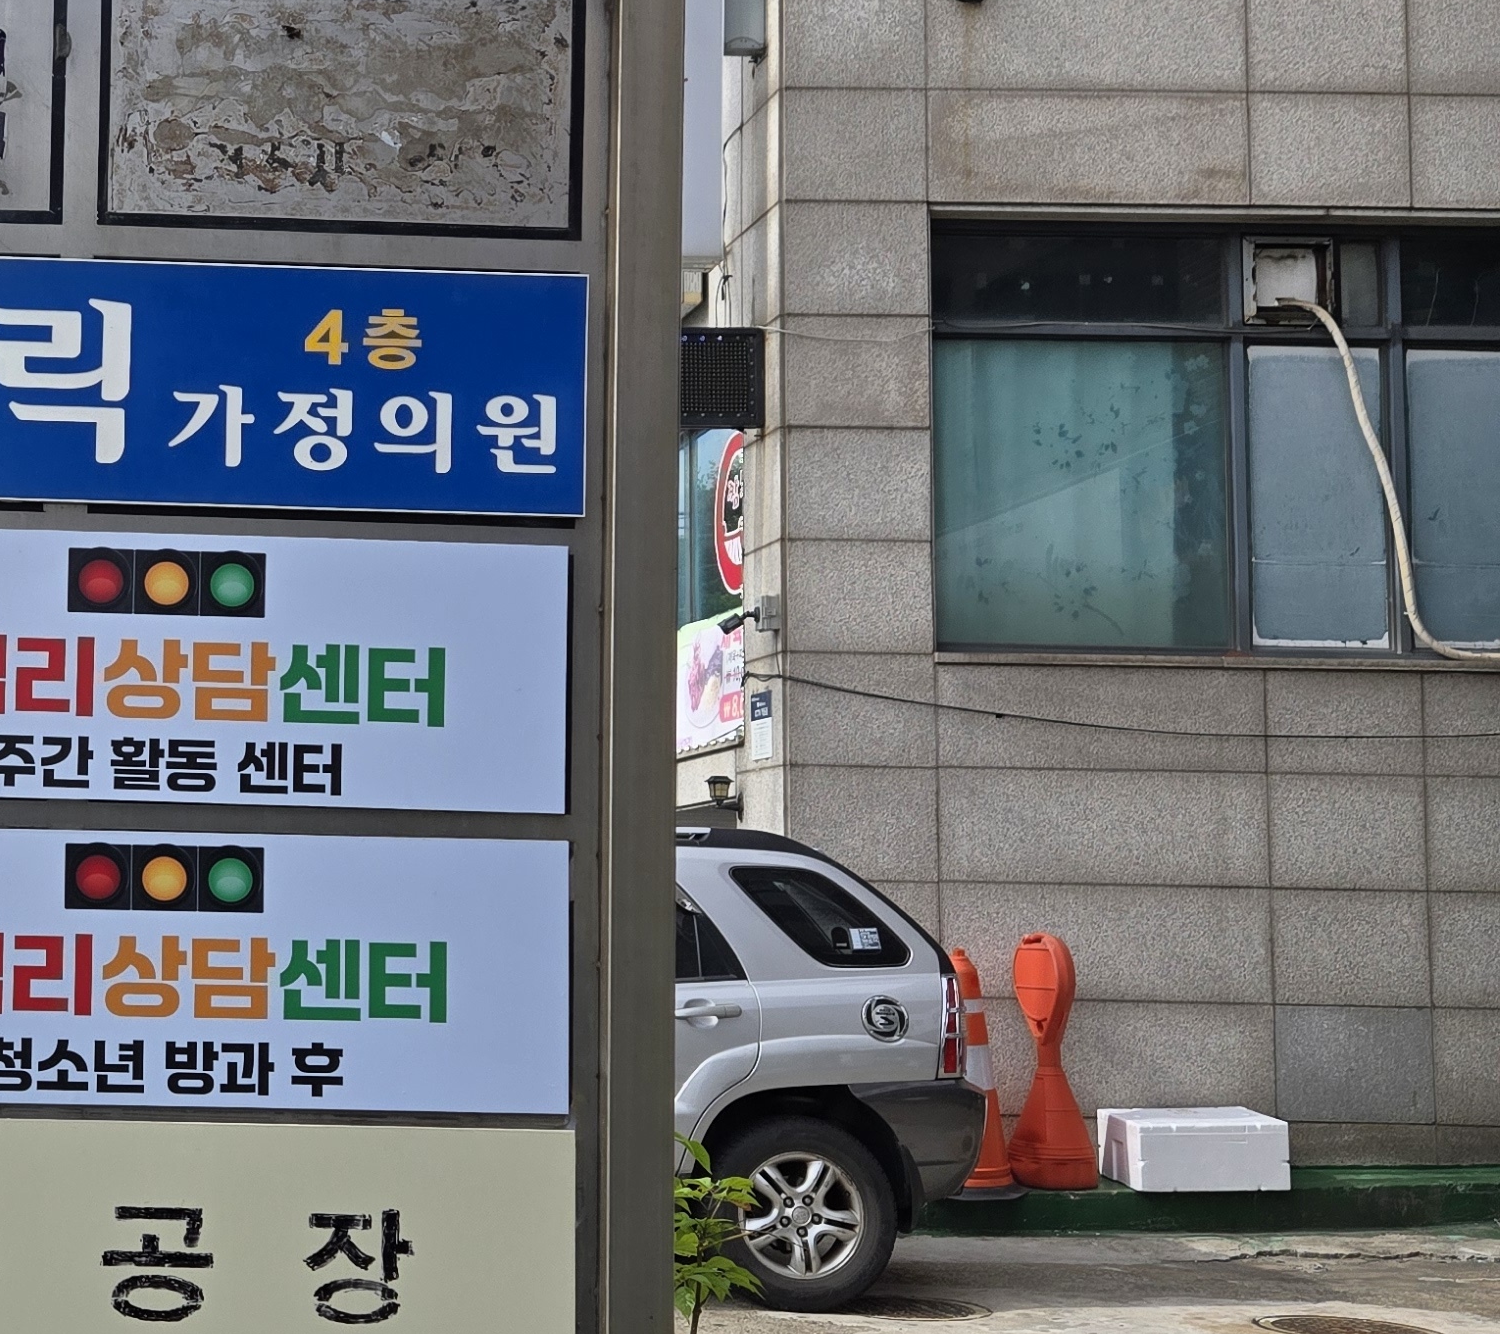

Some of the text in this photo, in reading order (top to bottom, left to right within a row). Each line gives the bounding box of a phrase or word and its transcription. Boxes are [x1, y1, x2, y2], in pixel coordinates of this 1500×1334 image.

[304, 308, 422, 370] 4층
[168, 384, 557, 474] 가정의원
[110, 736, 218, 793] 활동
[237, 741, 343, 797] 센터
[165, 1040, 275, 1097] 방과
[290, 1041, 344, 1098] 후
[102, 1206, 415, 1325] 공장
